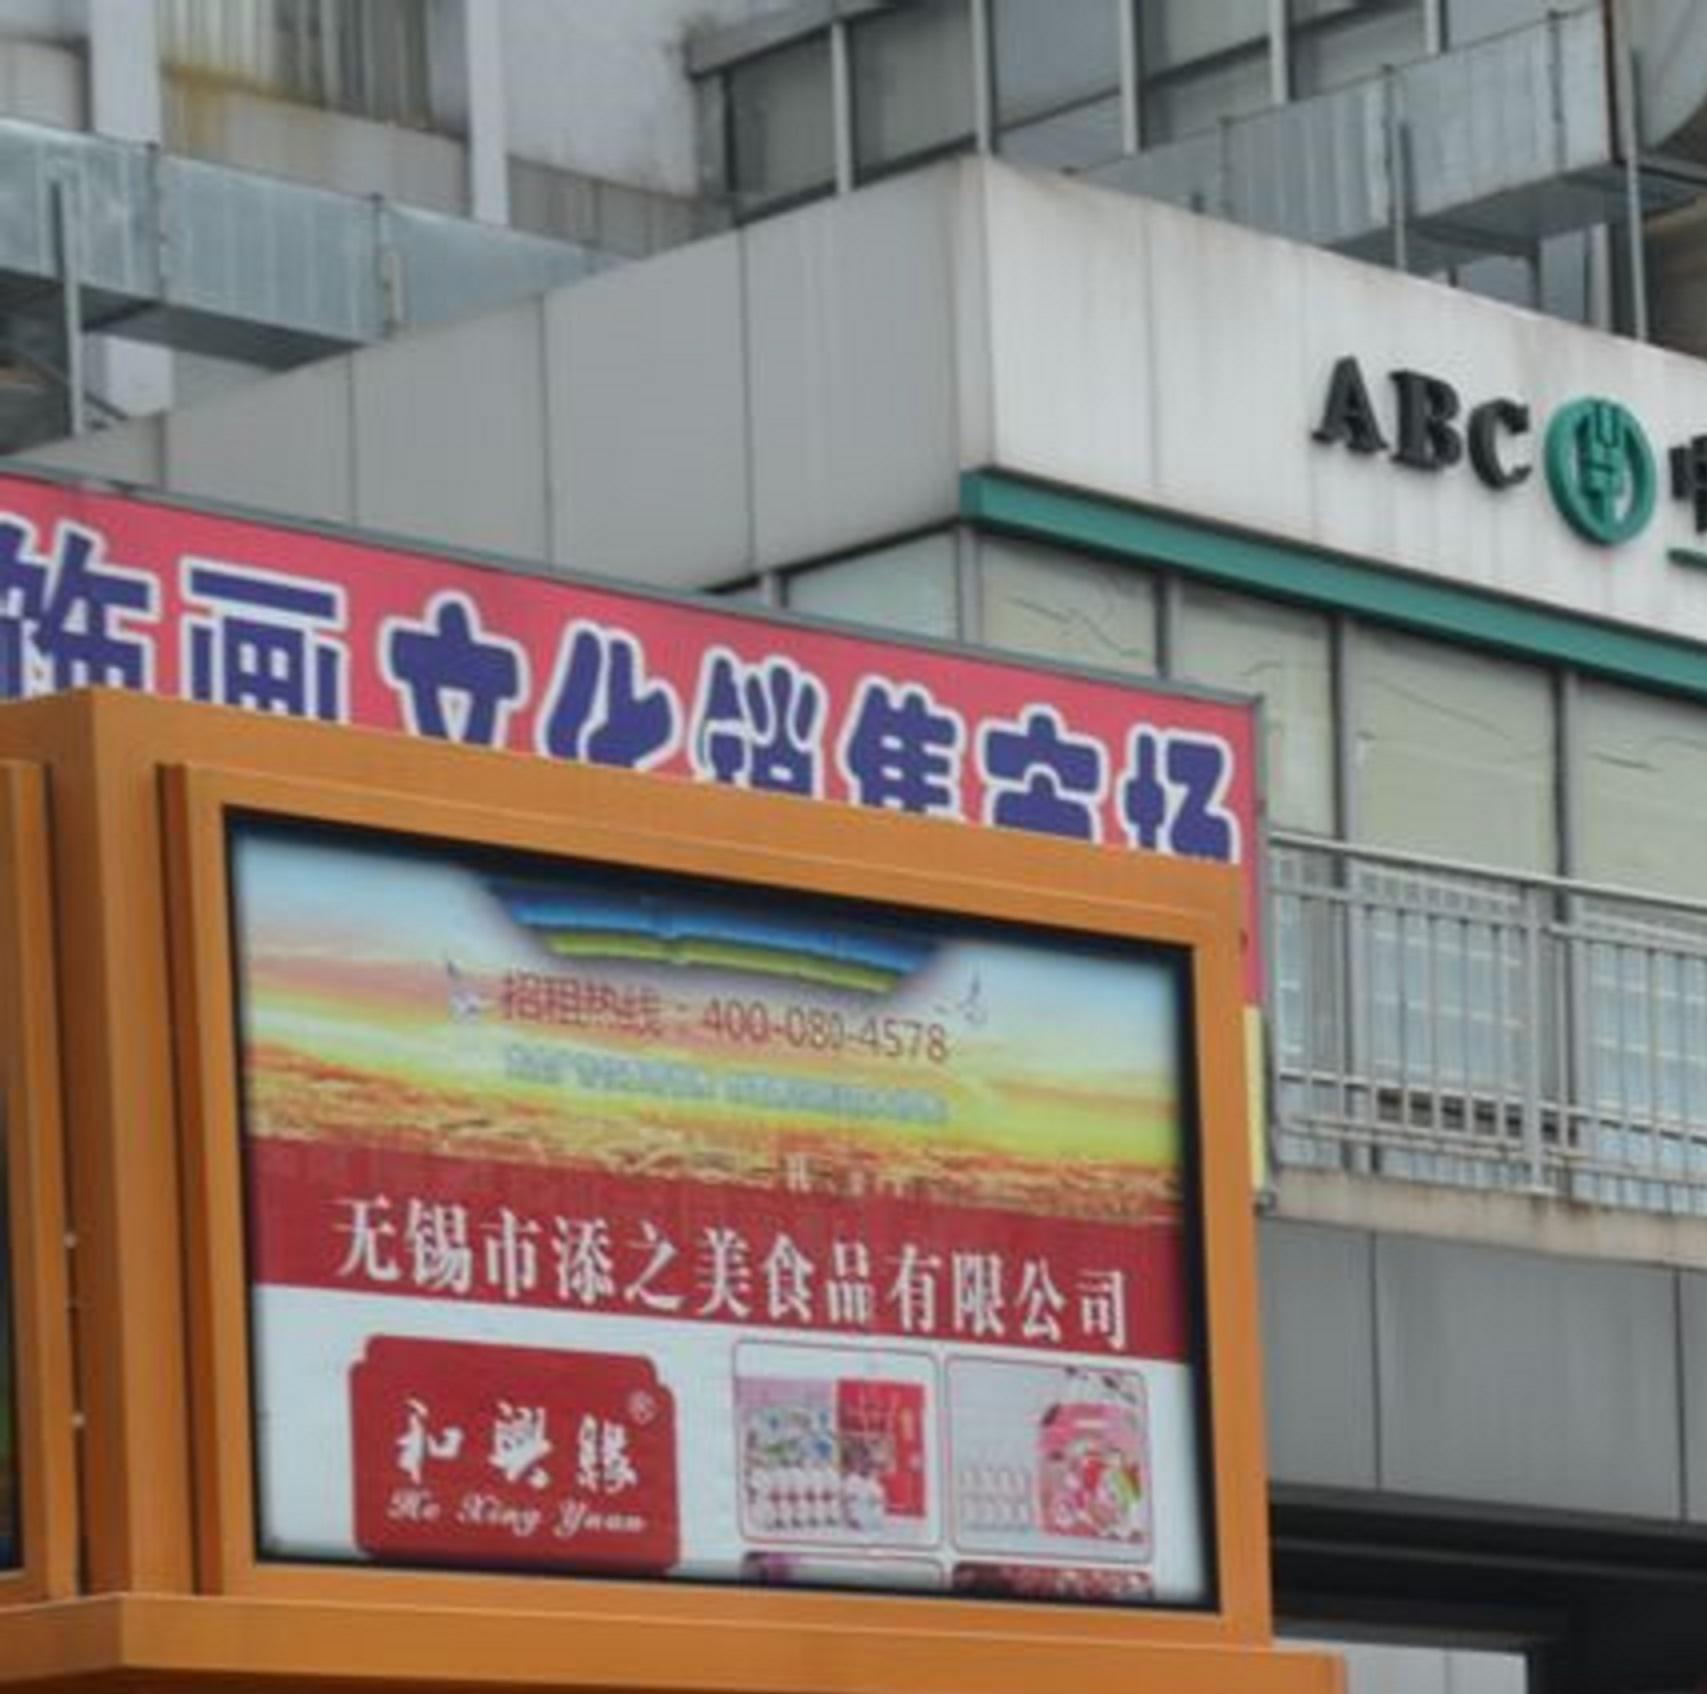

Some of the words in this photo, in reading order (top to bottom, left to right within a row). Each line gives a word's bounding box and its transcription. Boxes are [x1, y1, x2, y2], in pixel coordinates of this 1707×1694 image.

[1312, 355, 1533, 490] ABC
[334, 1194, 1127, 1348] 无锡市添之美食品有限公司
